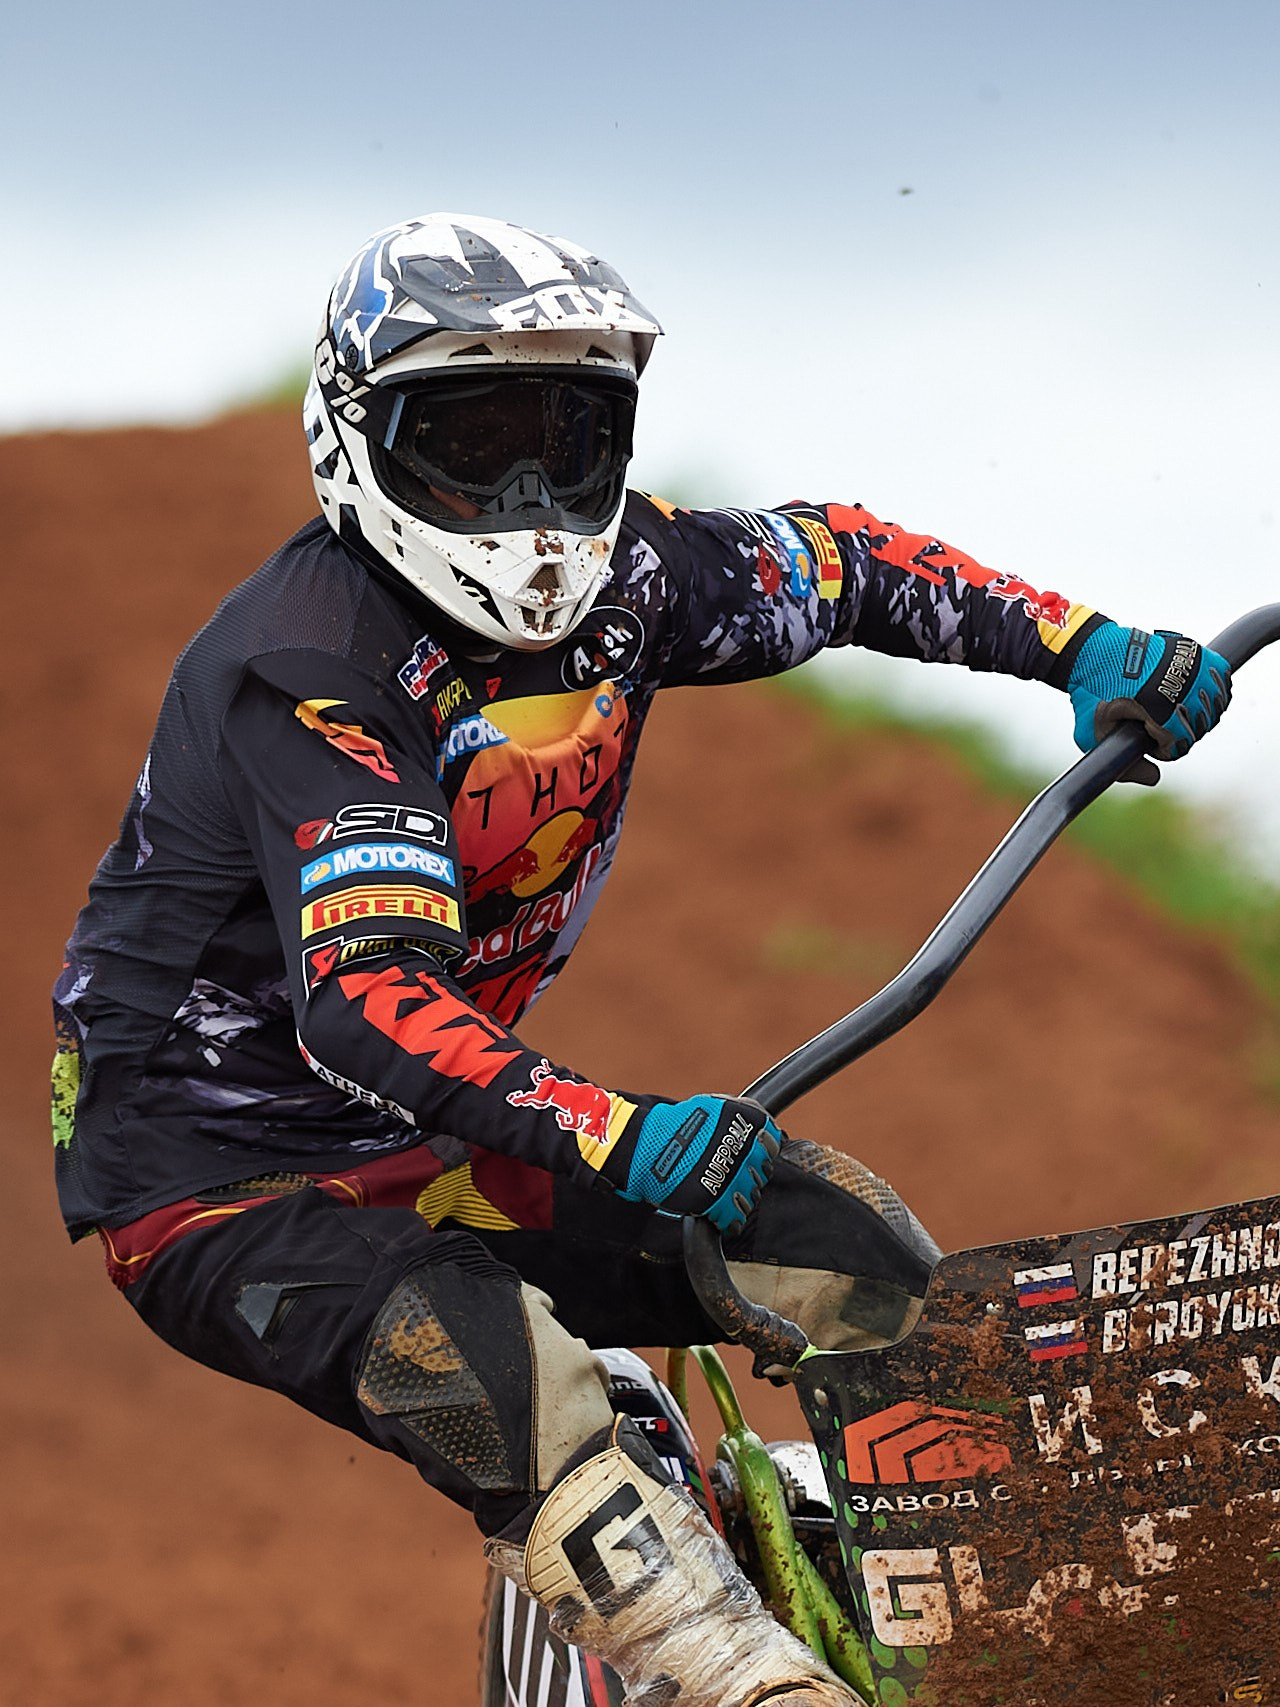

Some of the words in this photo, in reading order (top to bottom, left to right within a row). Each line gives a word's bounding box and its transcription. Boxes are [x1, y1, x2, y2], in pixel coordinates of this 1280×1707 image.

[488, 284, 638, 331] FOX
[333, 845, 452, 883] MOTOREX
[312, 893, 449, 931] PIRELLI
[700, 1113, 754, 1197] AUFPRALL
[852, 1490, 980, 1513] ЗАВОД
